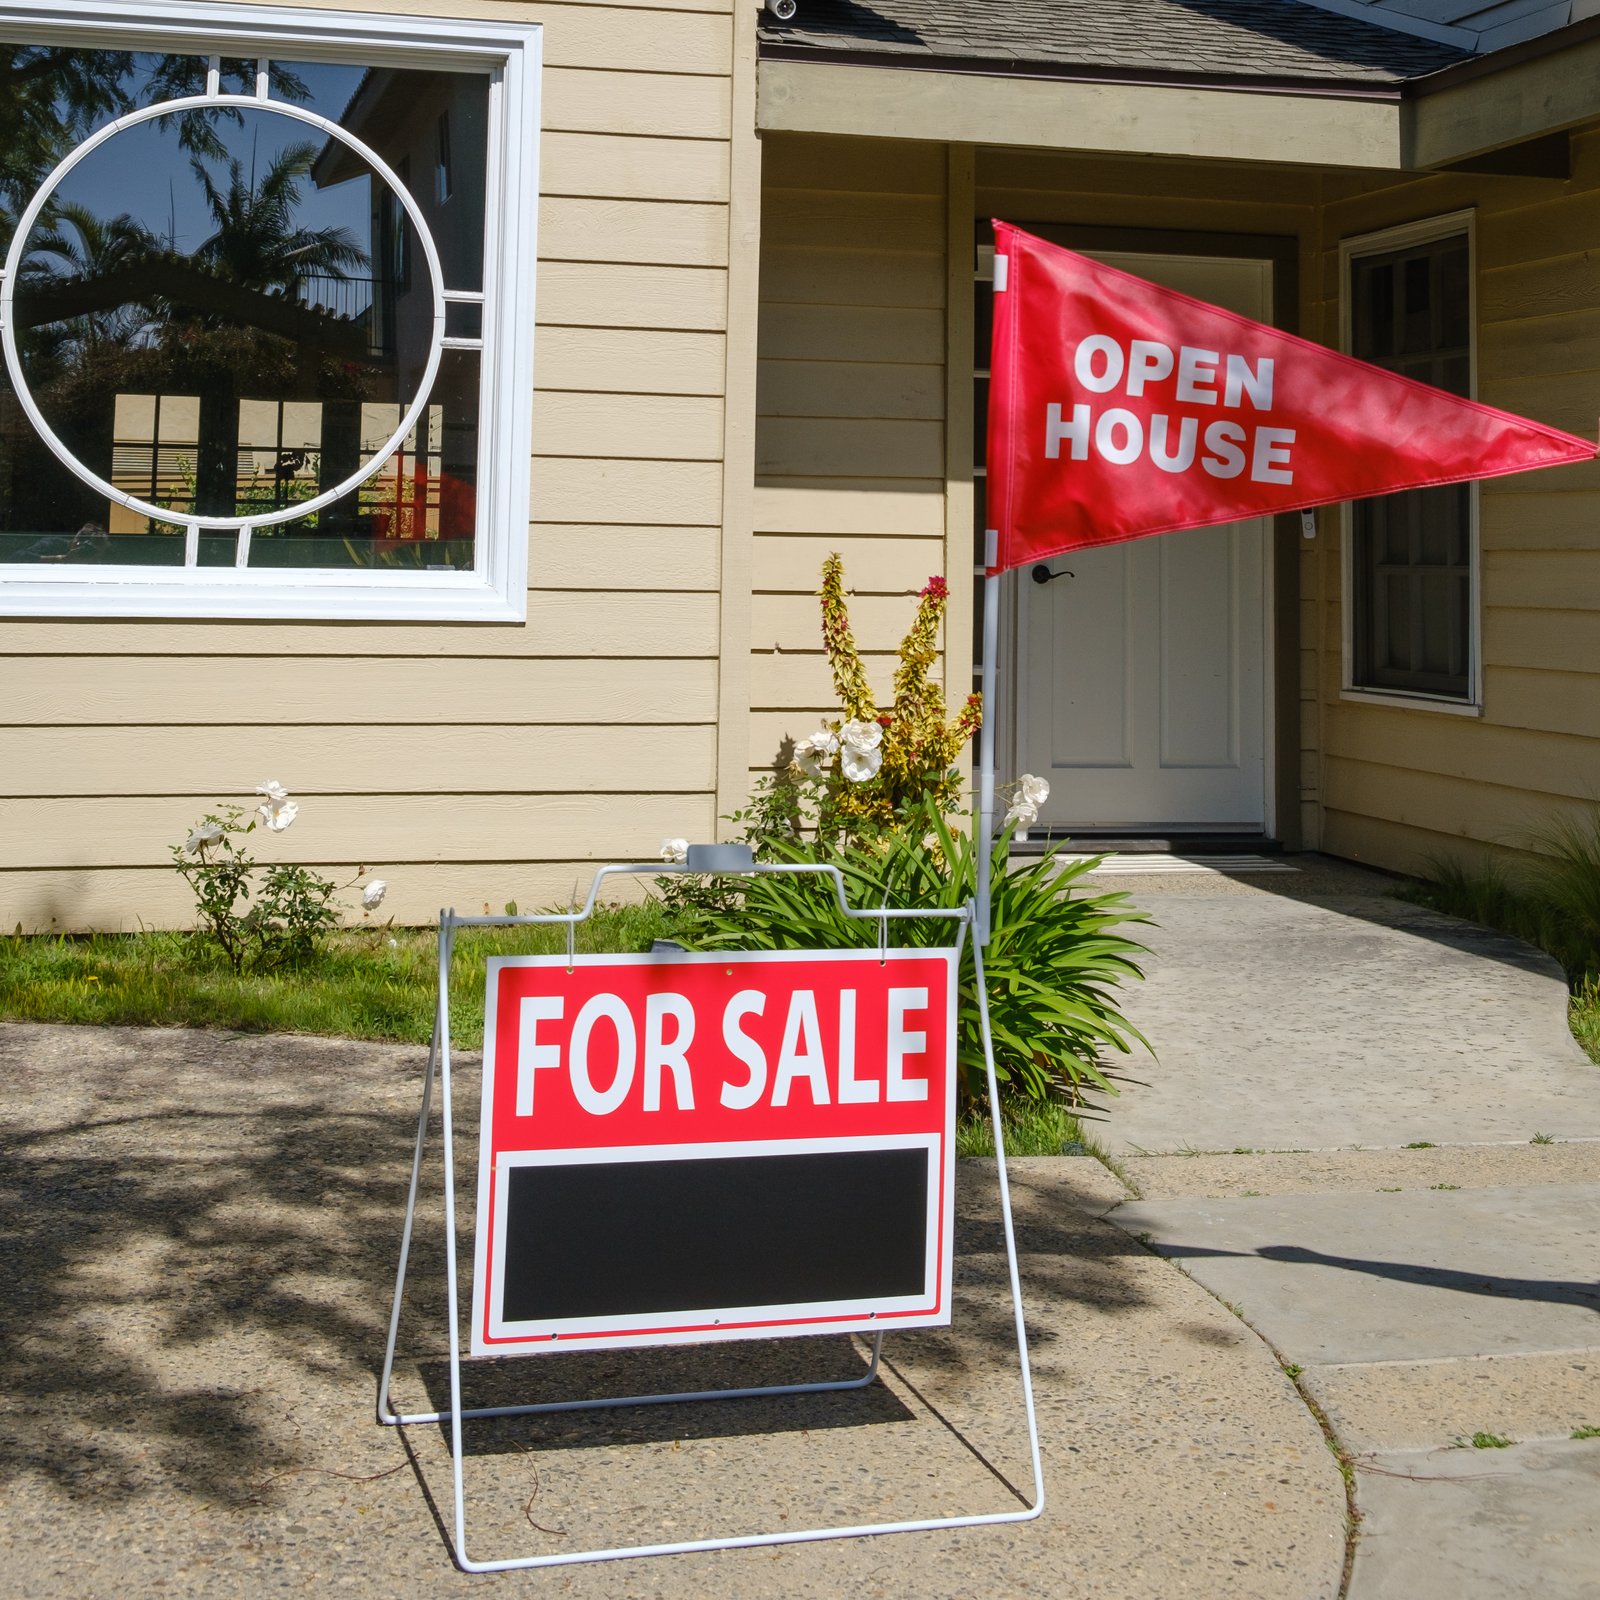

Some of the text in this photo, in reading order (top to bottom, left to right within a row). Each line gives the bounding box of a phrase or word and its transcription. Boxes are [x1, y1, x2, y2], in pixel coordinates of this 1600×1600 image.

[1073, 334, 1275, 411] OPEN
[1044, 402, 1297, 486] HOUSE
[515, 986, 930, 1118] FOR SALE
